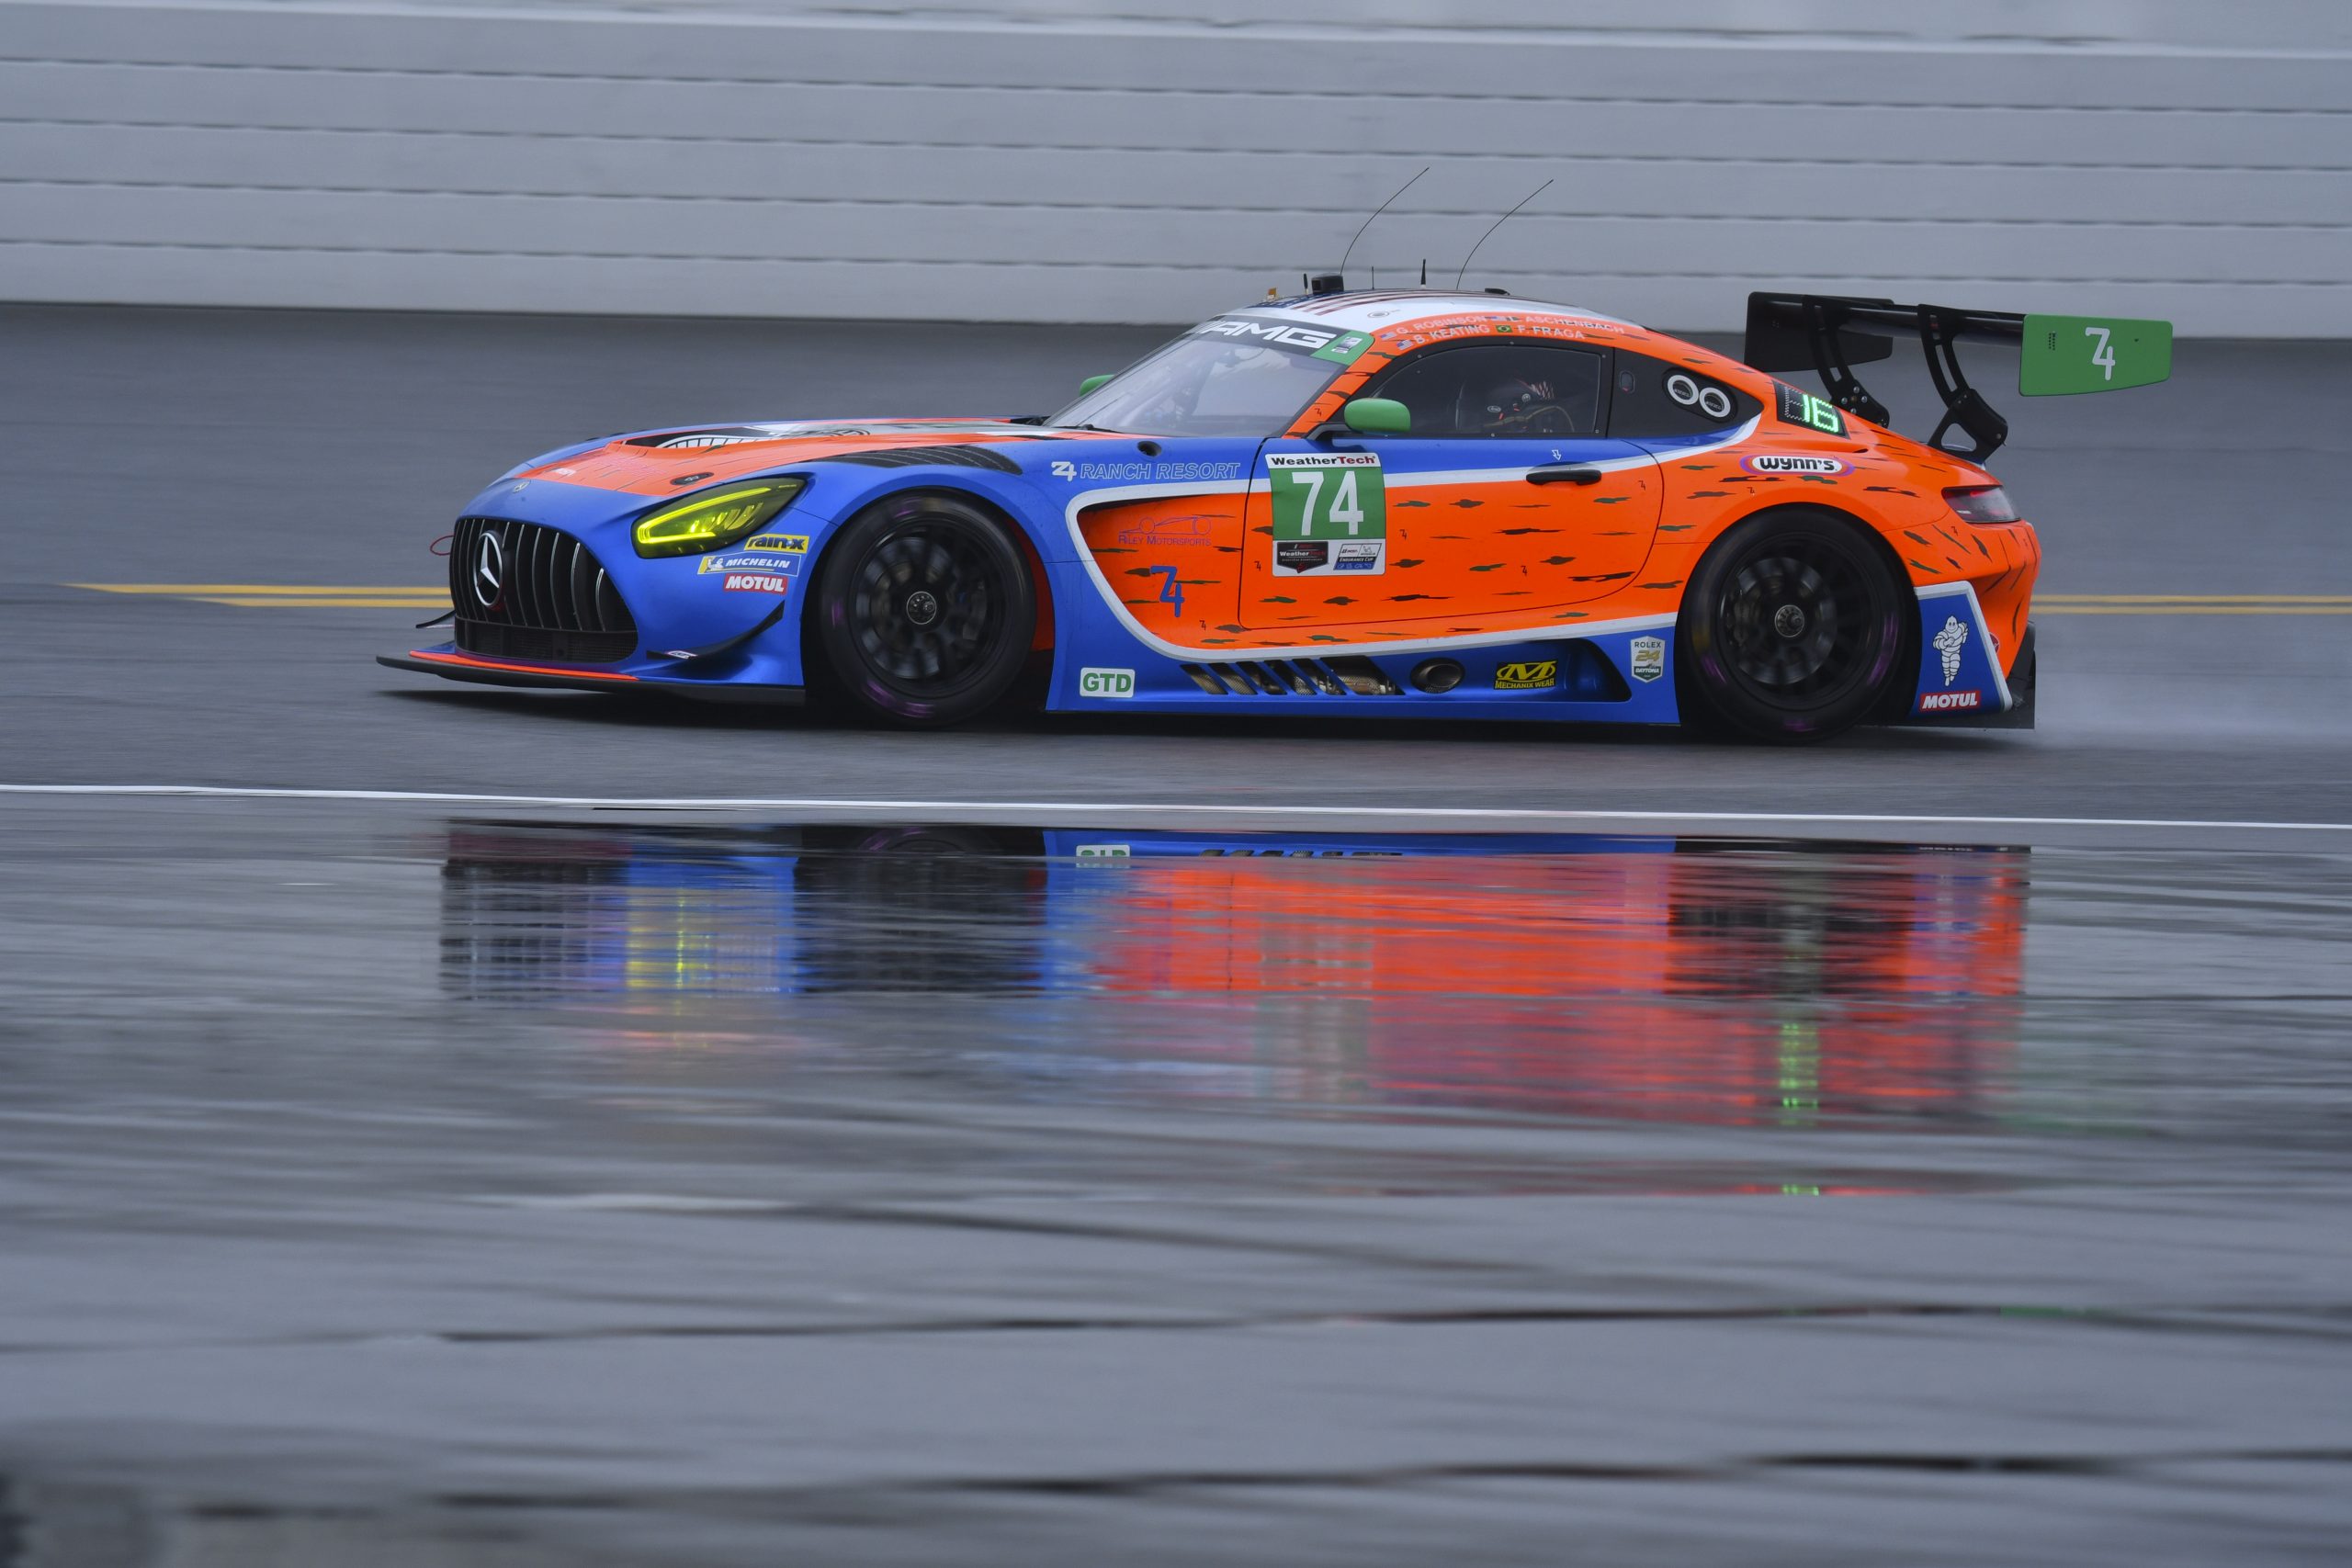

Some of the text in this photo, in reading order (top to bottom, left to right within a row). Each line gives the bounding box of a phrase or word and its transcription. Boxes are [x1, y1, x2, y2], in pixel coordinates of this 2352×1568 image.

[1415, 315, 1486, 331] ROBINSON
[1526, 315, 1624, 333] ASCHENBACH
[1200, 321, 1337, 349] AMG
[1430, 325, 1490, 340] KEATING
[1533, 326, 1585, 340] FRAGA
[1272, 456, 1376, 466] WeatherTech
[1080, 462, 1151, 479] RANCH
[1155, 462, 1240, 479] RESORT
[1292, 470, 1363, 536] 74
[1118, 535, 1212, 546] RILEY MOTORSPORTS
[725, 558, 791, 569] MICHELIN
[725, 575, 785, 592] MOTUL
[1635, 649, 1660, 661] 24
[1082, 672, 1132, 693] GTD
[1495, 678, 1555, 689] MECHANIX WEAR
[1922, 692, 1977, 709] MOTUL
